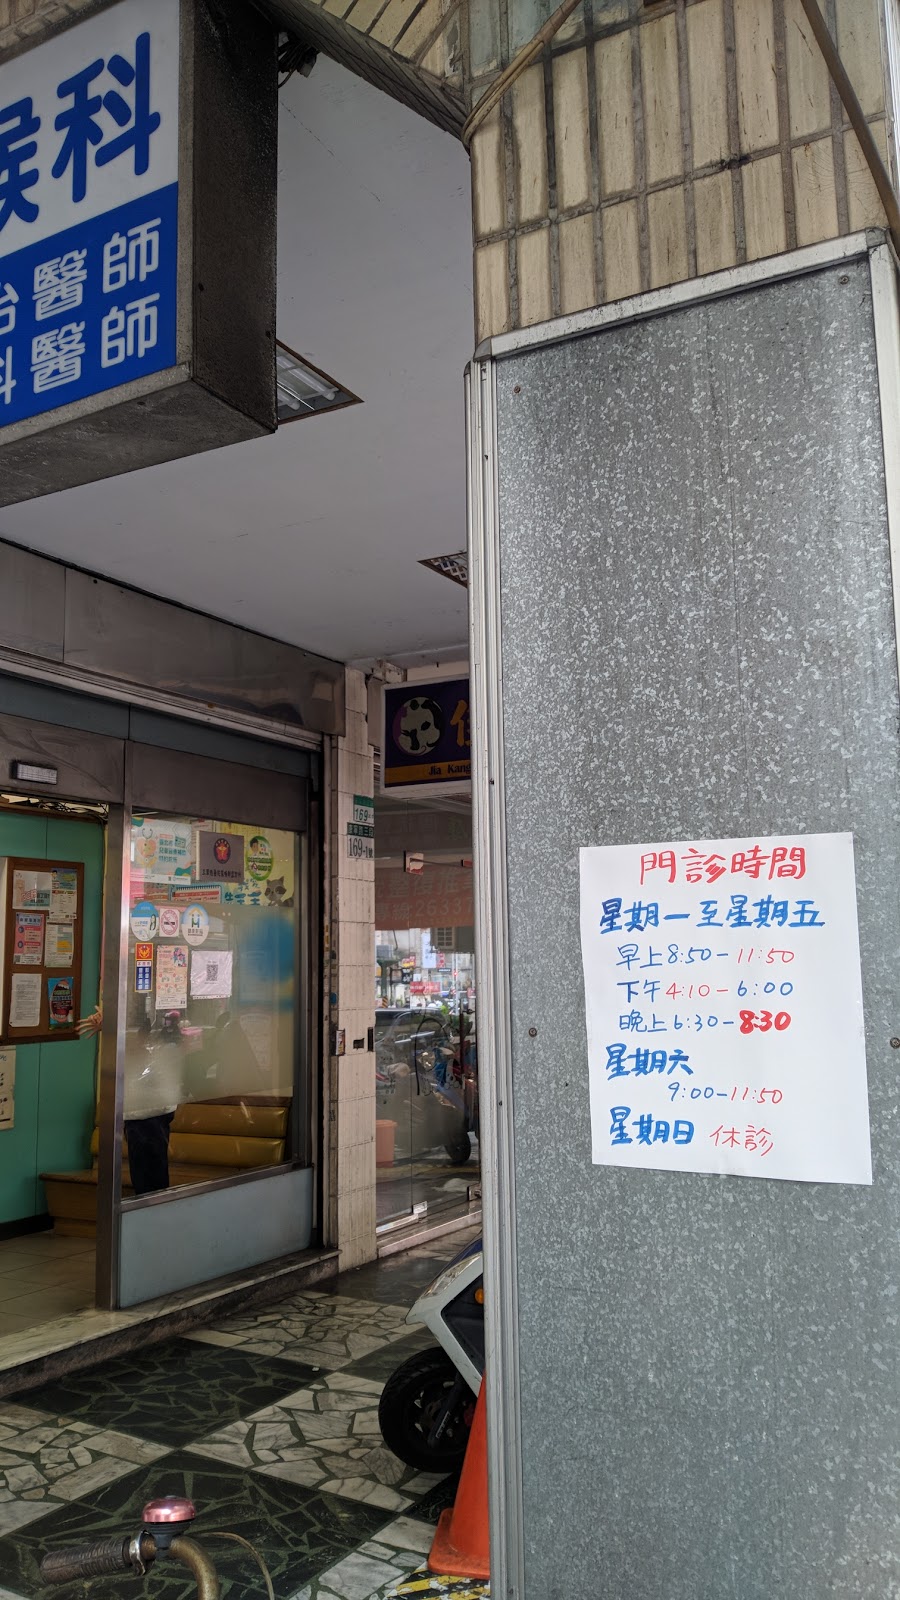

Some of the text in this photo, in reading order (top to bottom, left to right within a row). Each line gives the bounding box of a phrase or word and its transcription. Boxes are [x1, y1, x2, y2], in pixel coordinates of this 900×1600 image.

[428, 765, 442, 776] Jia
[640, 845, 807, 885] 門診時間
[600, 895, 826, 935] 星期一至星期五
[606, 1043, 694, 1081] 星期六
[668, 1082, 783, 1105] 9:00-11:50
[610, 1106, 774, 1157] 星期日 休診
